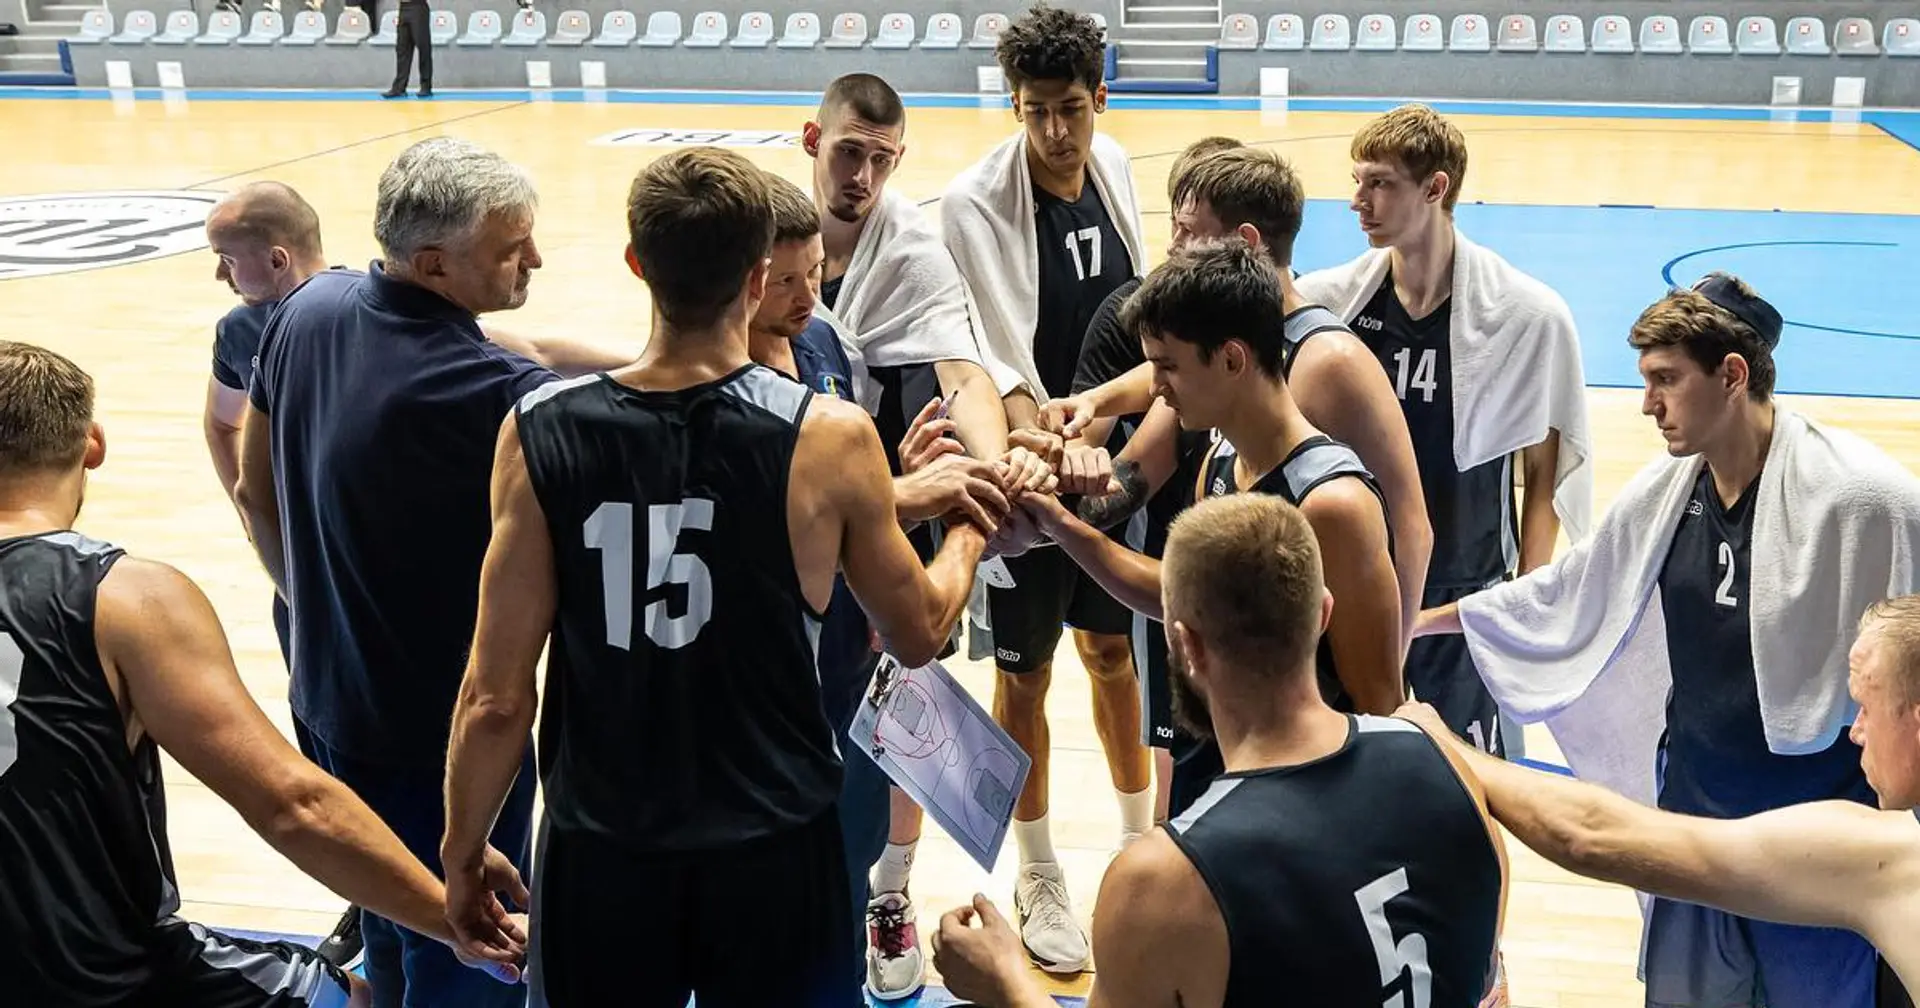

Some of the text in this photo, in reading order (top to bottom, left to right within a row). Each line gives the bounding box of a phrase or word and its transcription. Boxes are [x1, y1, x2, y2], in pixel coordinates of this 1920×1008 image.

[1065, 225, 1102, 281] 17
[1394, 348, 1437, 402] 14
[583, 498, 715, 652] 15
[1715, 541, 1738, 607] 2
[1353, 866, 1433, 1008] 5
